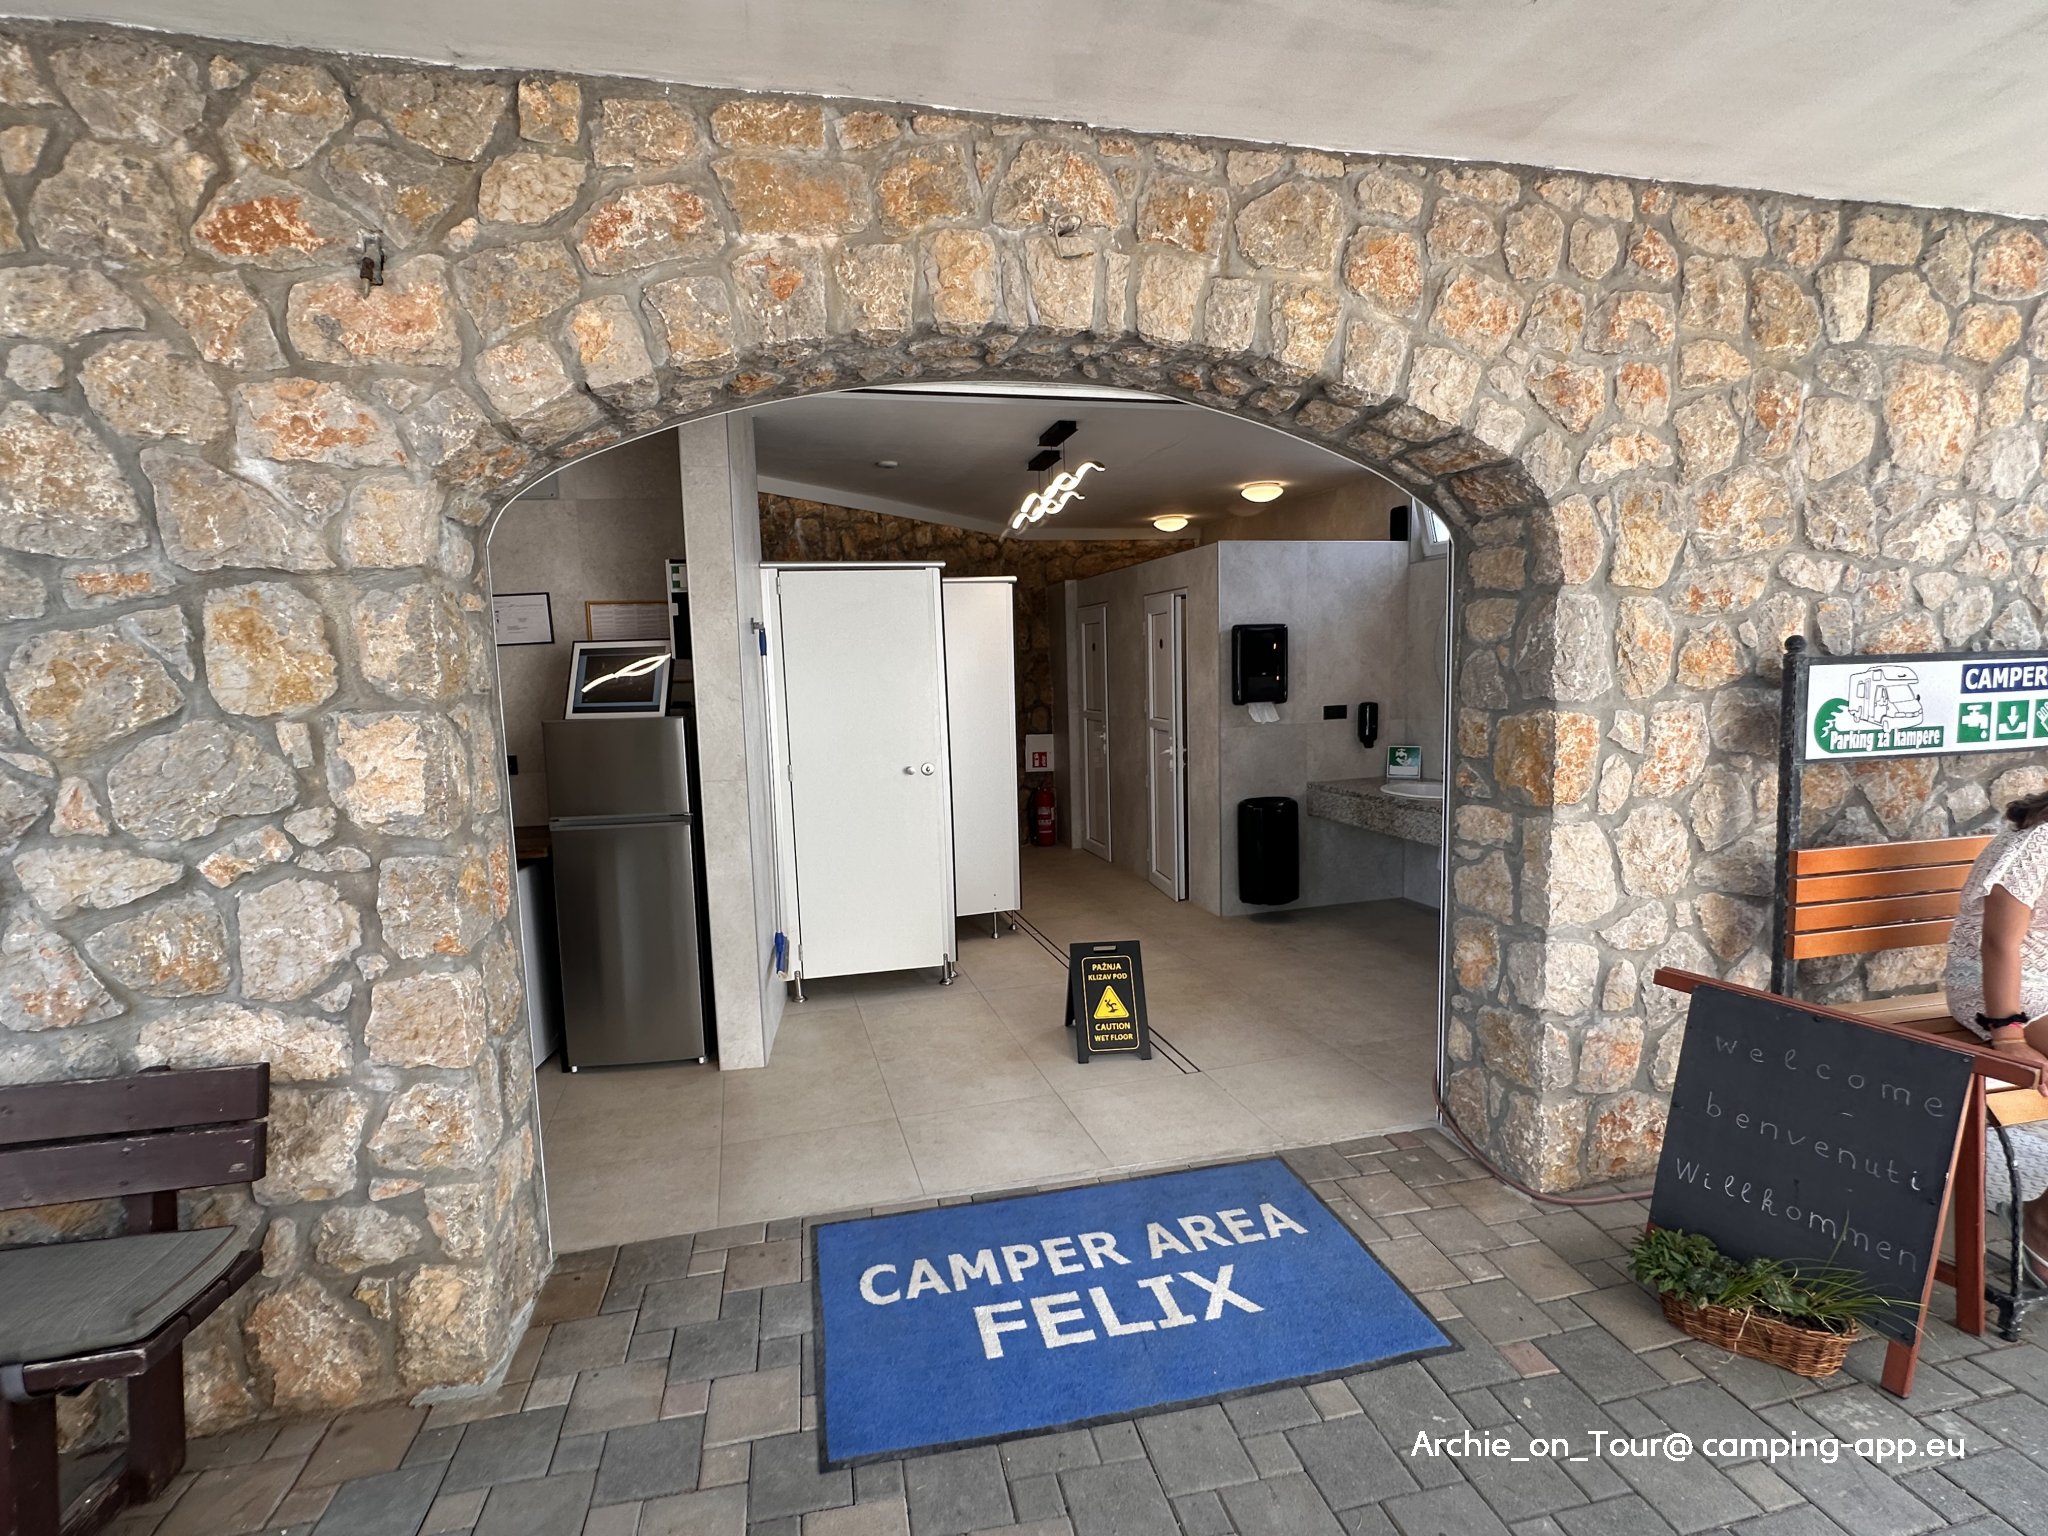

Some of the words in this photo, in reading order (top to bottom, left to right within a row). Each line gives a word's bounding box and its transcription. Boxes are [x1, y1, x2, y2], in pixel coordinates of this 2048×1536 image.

[1830, 729, 1873, 752] Parking
[1877, 733, 1890, 748] za
[1894, 727, 1940, 749] kampere
[1092, 962, 1121, 971] PAŽNJA
[1113, 972, 1128, 980] POD
[1095, 1022, 1130, 1031] CAUTION
[1110, 1033, 1133, 1041] FLOOR
[1715, 1035, 1945, 1118] welcome
[1706, 1091, 1922, 1192] benvenuti
[1676, 1157, 1918, 1273] Willkommen
[859, 1231, 1132, 1306] CAMPER
[1146, 1202, 1309, 1260] AREA
[972, 1264, 1265, 1360] FELIX
